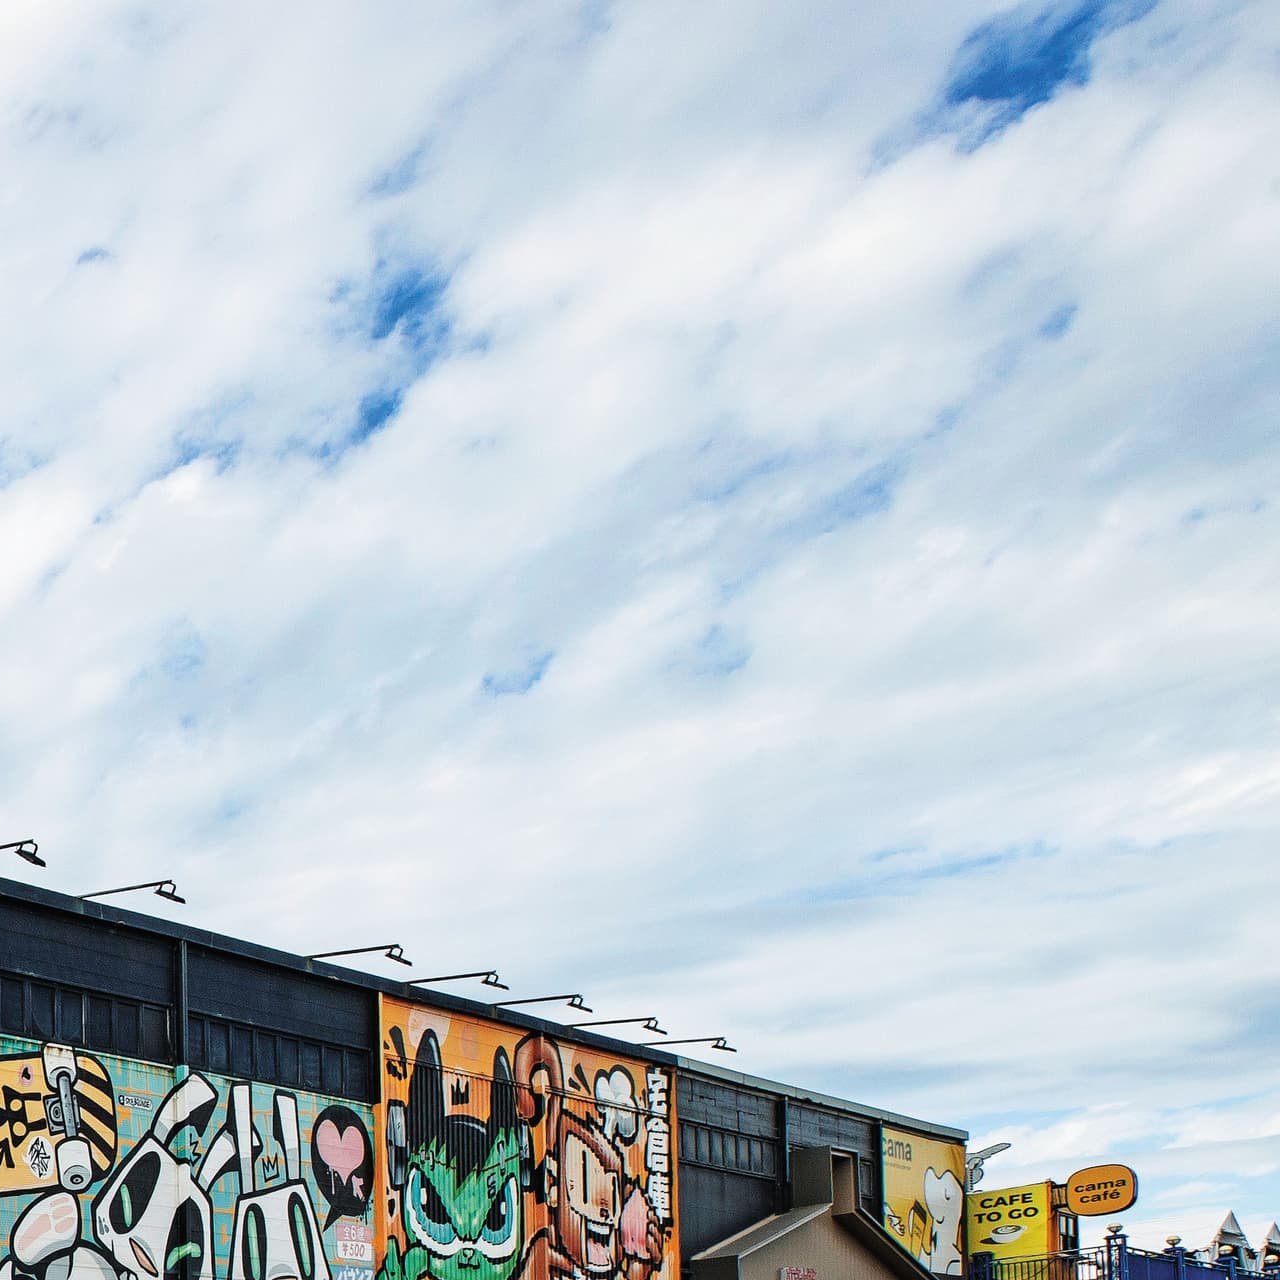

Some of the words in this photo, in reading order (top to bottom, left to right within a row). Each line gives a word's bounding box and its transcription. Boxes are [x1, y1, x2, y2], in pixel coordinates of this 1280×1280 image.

[1074, 1178, 1127, 1193] cama
[980, 1192, 1033, 1209] CAFE
[1079, 1188, 1121, 1204] café
[973, 1211, 1002, 1224] TO
[1007, 1206, 1039, 1219] GO
